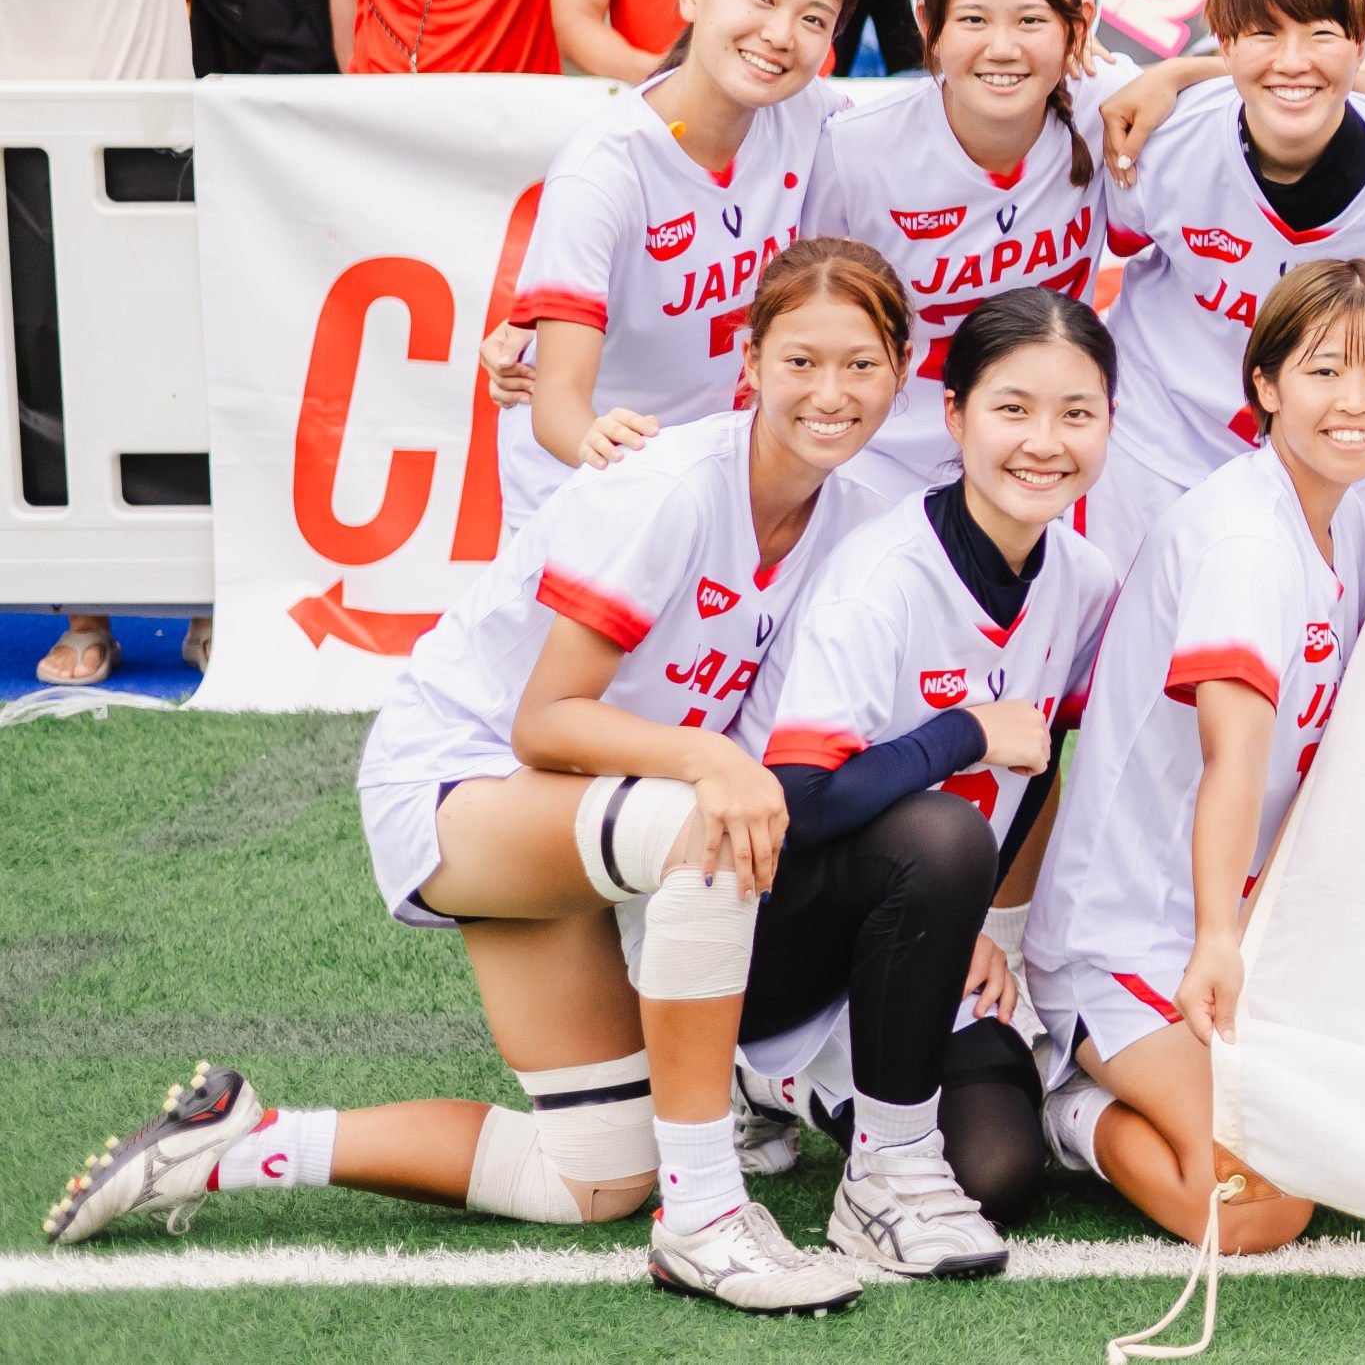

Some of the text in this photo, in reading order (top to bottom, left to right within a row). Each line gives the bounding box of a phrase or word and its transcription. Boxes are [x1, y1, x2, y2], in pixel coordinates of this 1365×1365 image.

[899, 210, 959, 232] NISSIN
[911, 206, 1092, 295] JAPAN
[1189, 229, 1243, 258] NISSIN
